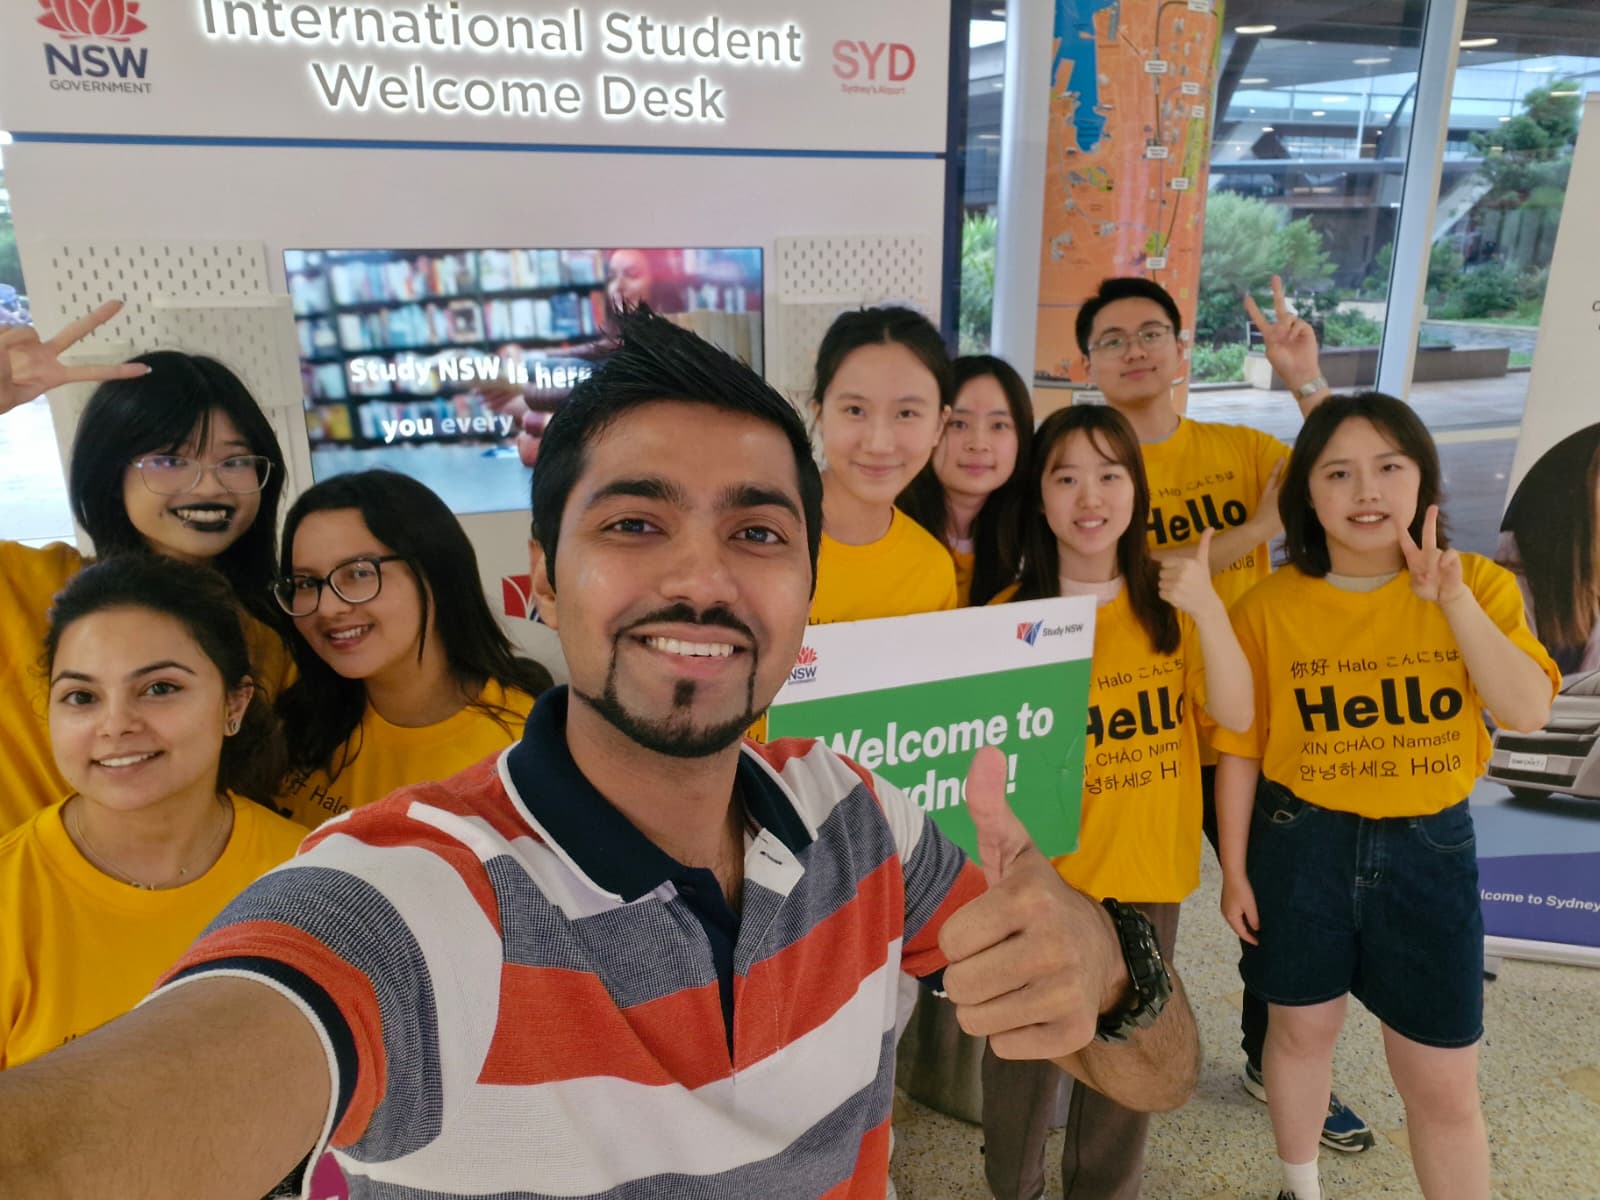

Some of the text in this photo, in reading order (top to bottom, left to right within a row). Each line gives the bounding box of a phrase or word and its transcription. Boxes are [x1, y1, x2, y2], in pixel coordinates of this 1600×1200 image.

[204, 0, 801, 62] International Student
[43, 43, 148, 78] NSW
[832, 39, 916, 81] SYD
[49, 80, 152, 93] GOVERNMENT
[312, 63, 725, 119] Welcome Desk
[350, 357, 431, 385] Study
[439, 356, 500, 381] NSW
[382, 414, 514, 444] you every
[1147, 493, 1247, 545] Hello
[1042, 624, 1084, 637] Study NSW
[788, 666, 817, 680] NSW
[1097, 658, 1184, 691] Halo こんにち
[1291, 649, 1461, 679] 你好 Halo こんにちは
[1294, 676, 1463, 732] Hello
[1016, 702, 1054, 740] to
[1301, 742, 1328, 755] XIN
[1393, 730, 1461, 749] Namaste
[1300, 753, 1461, 782] 안녕하세요 Hola
[1086, 773, 1152, 795] 녕하세요
[1480, 889, 1600, 912] lcome to Sydney
